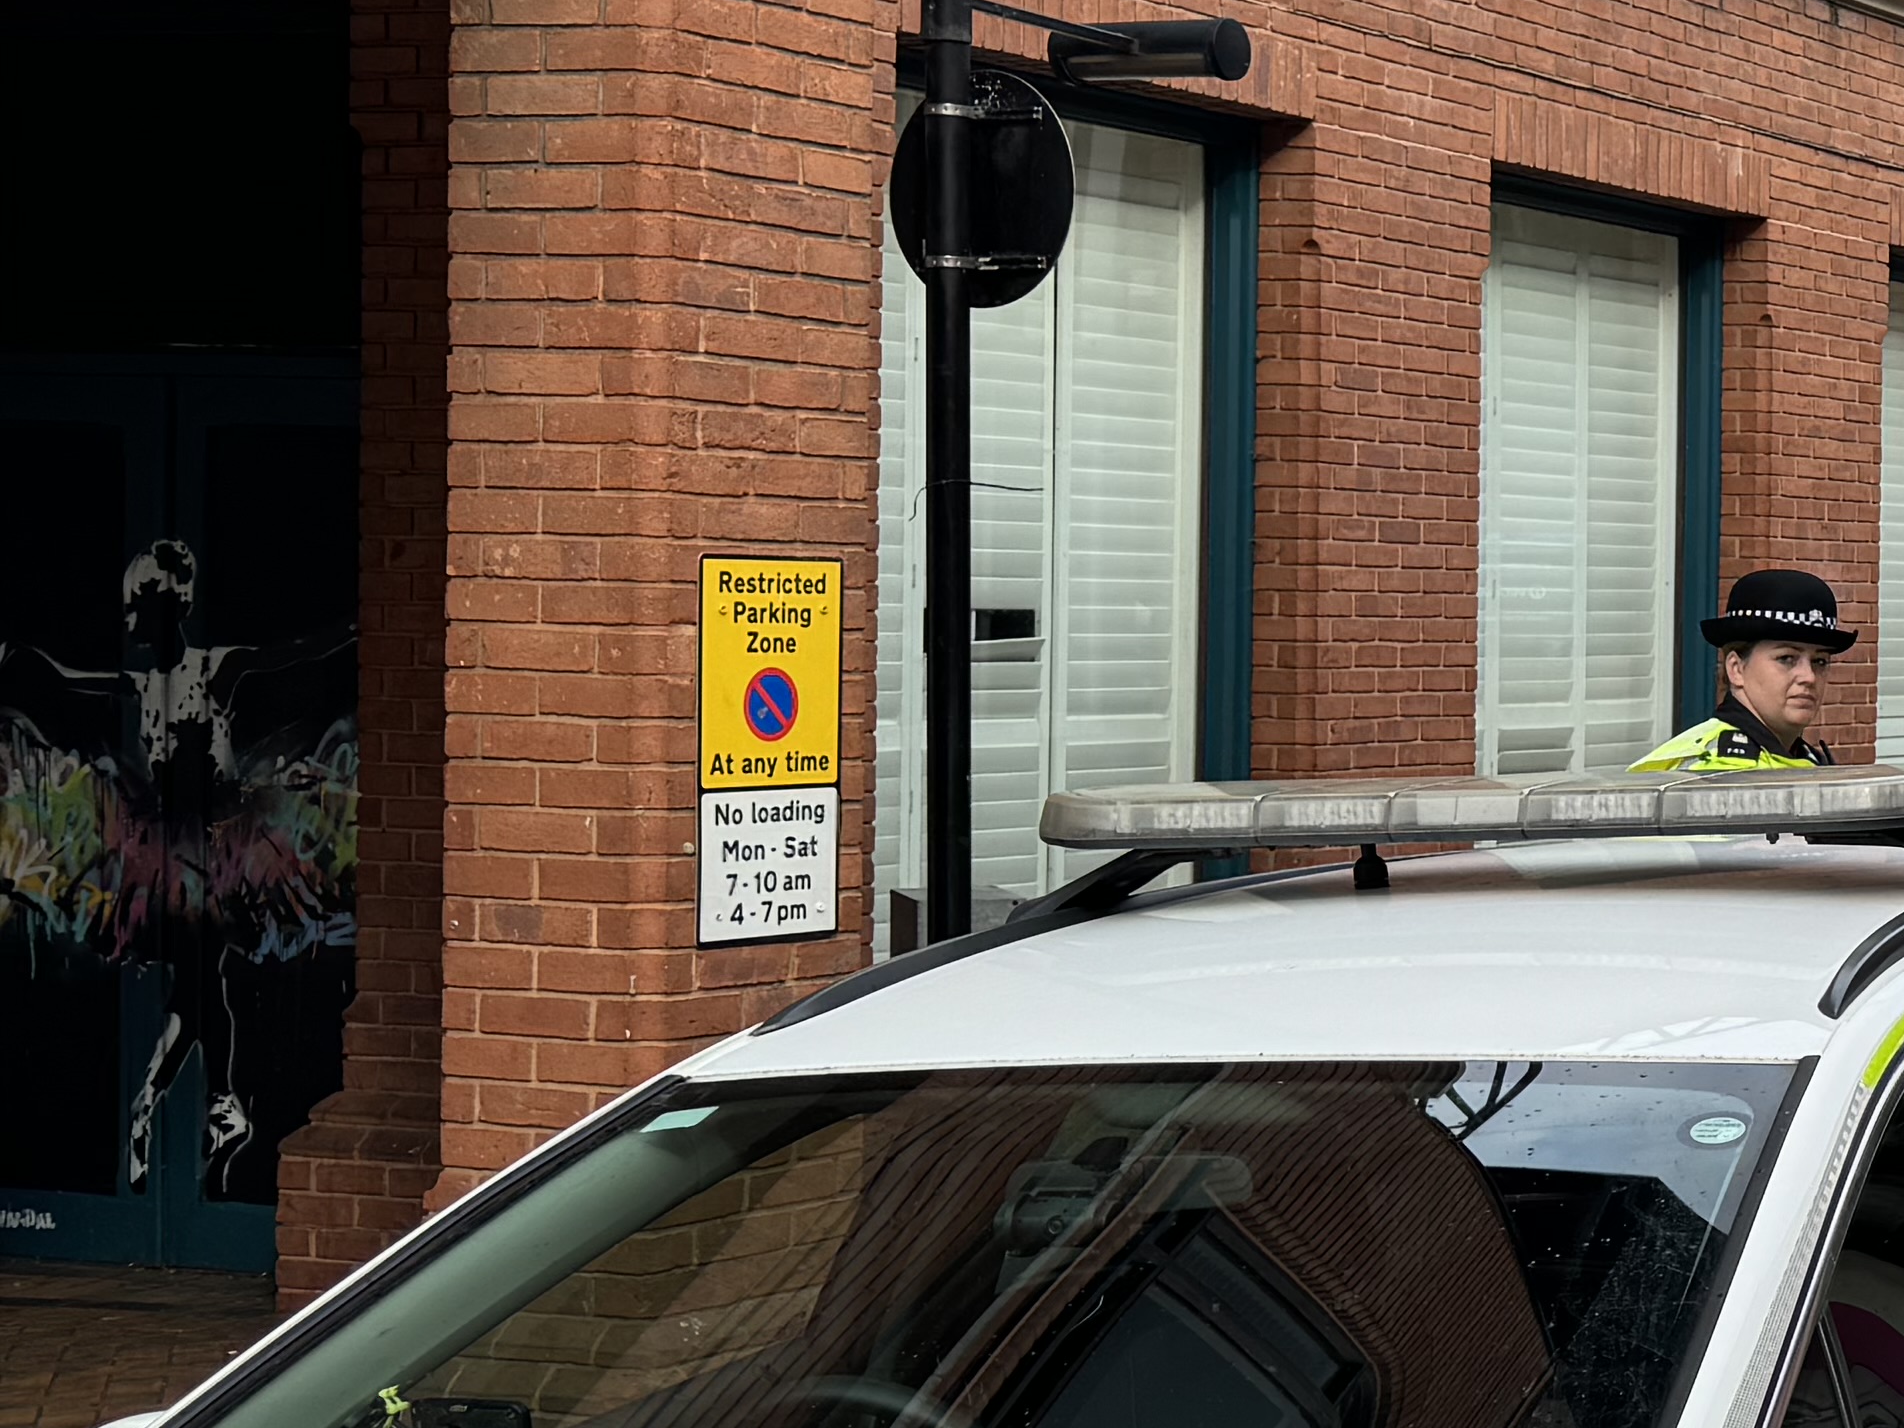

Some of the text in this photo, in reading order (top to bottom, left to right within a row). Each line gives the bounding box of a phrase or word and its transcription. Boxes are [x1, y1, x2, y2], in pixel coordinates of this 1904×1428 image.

[719, 572, 826, 595] Restricted
[733, 602, 812, 628] Parking
[747, 632, 796, 653] Zone
[710, 751, 829, 776] At any time
[715, 800, 825, 826] No loading
[722, 840, 764, 862] Mon
[784, 836, 818, 858] Sat
